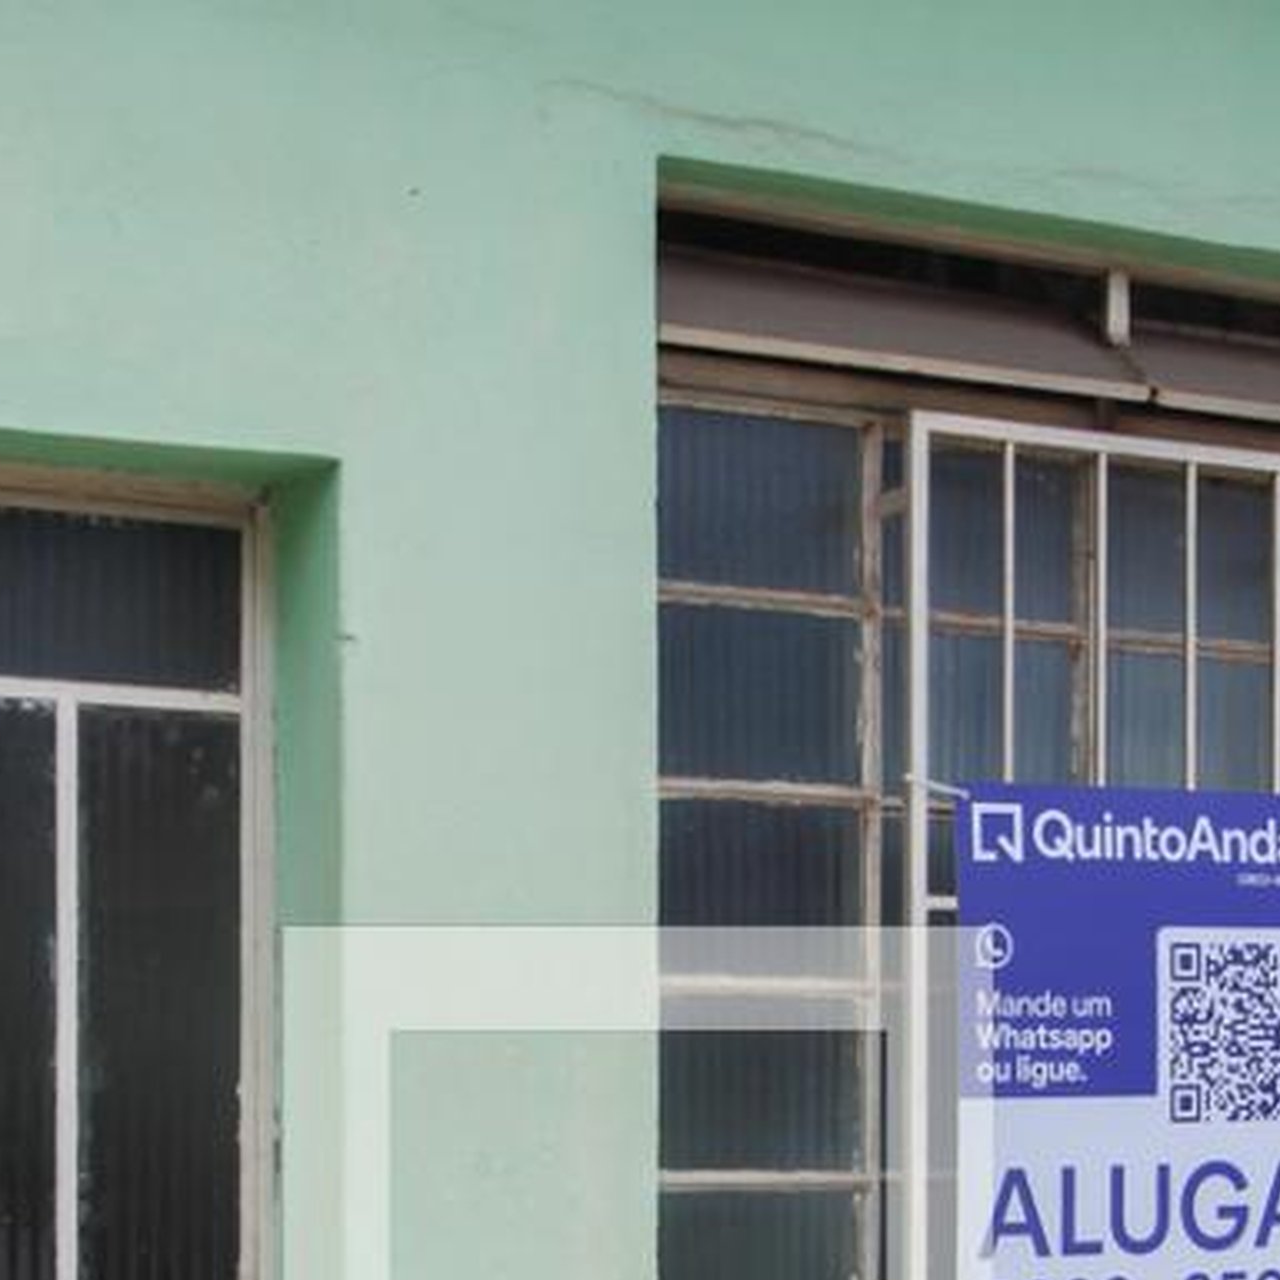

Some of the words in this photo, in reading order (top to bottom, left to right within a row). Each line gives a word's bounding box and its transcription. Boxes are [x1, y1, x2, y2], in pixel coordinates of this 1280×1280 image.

[976, 989, 1067, 1018] Mande
[1072, 995, 1112, 1017] um
[976, 1022, 1113, 1056] Whatsapp
[976, 1061, 1011, 1083] ou
[1015, 1053, 1088, 1089] ligue.
